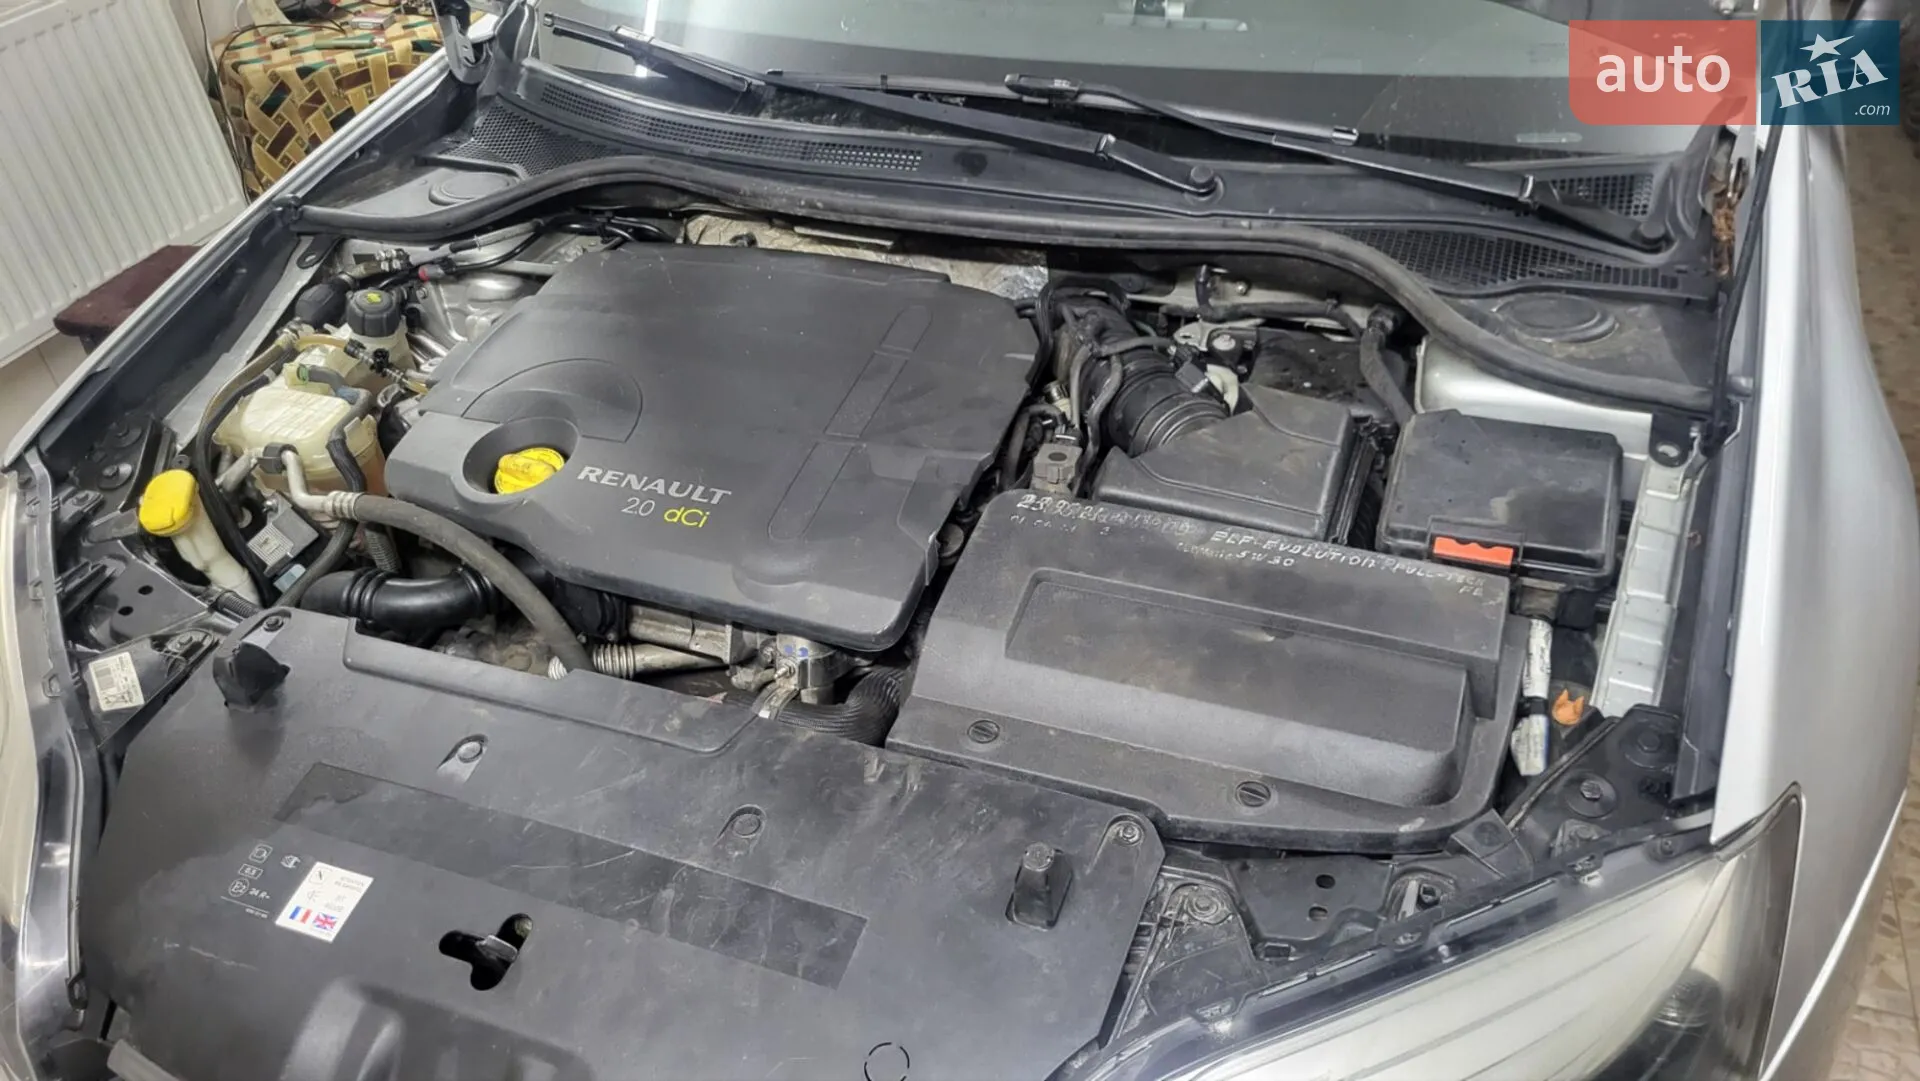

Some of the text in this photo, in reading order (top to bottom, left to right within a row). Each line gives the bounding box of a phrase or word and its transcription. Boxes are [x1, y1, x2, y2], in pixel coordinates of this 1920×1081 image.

[576, 465, 733, 505] RENAULT
[621, 496, 710, 528] 2.0 dCi
